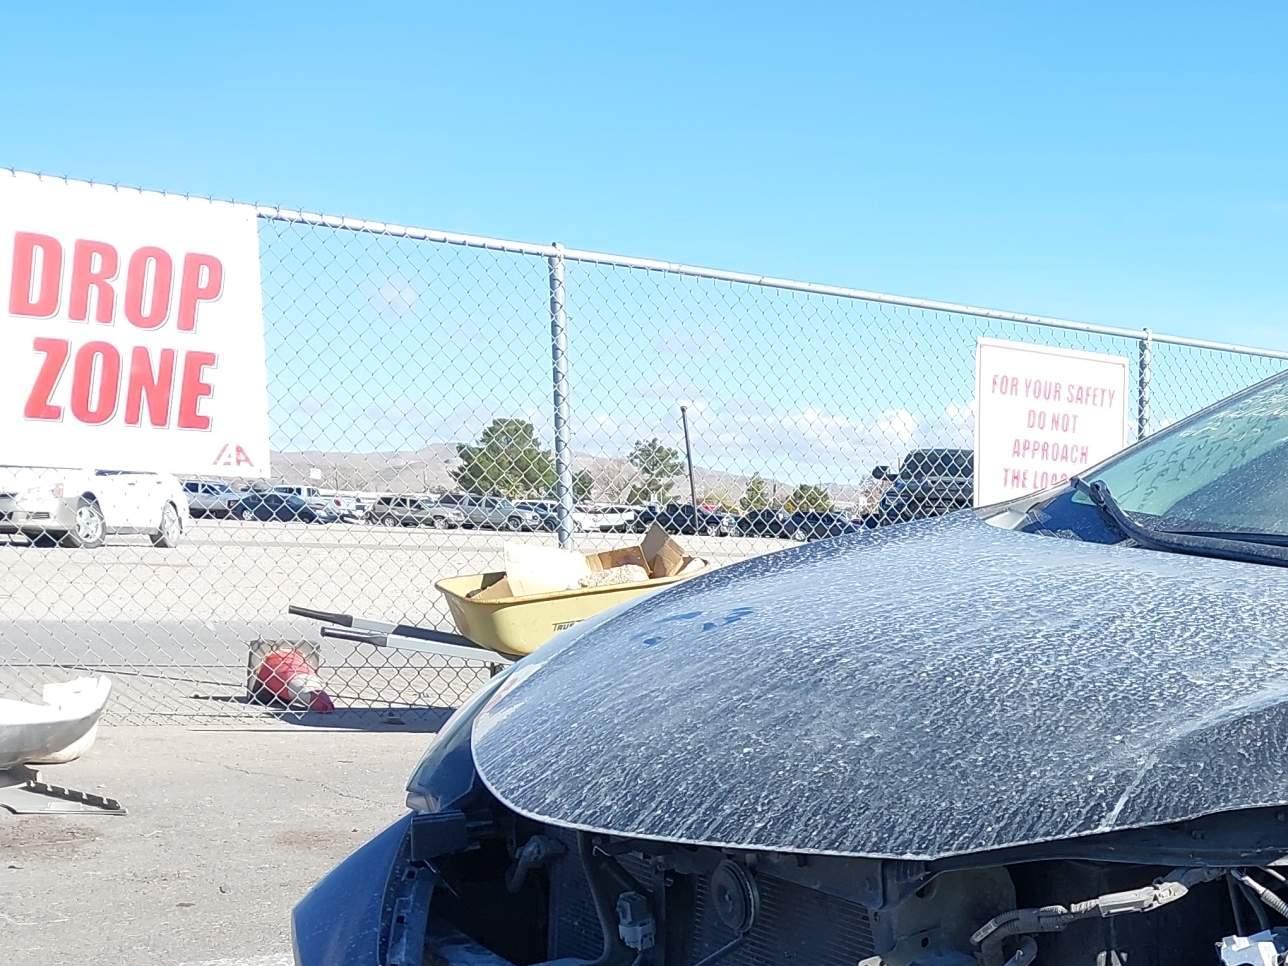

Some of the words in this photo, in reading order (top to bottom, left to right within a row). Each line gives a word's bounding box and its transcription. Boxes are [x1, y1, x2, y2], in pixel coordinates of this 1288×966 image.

[9, 231, 222, 332] DROP
[24, 336, 218, 431] ZONE
[992, 375, 1018, 396] FOR
[1025, 378, 1062, 401] YOUR
[1067, 384, 1115, 408] SAFETY
[1027, 409, 1047, 430] DO
[1051, 412, 1079, 433] NOT
[1012, 438, 1088, 464] APPROACH
[1003, 468, 1027, 489] THE
